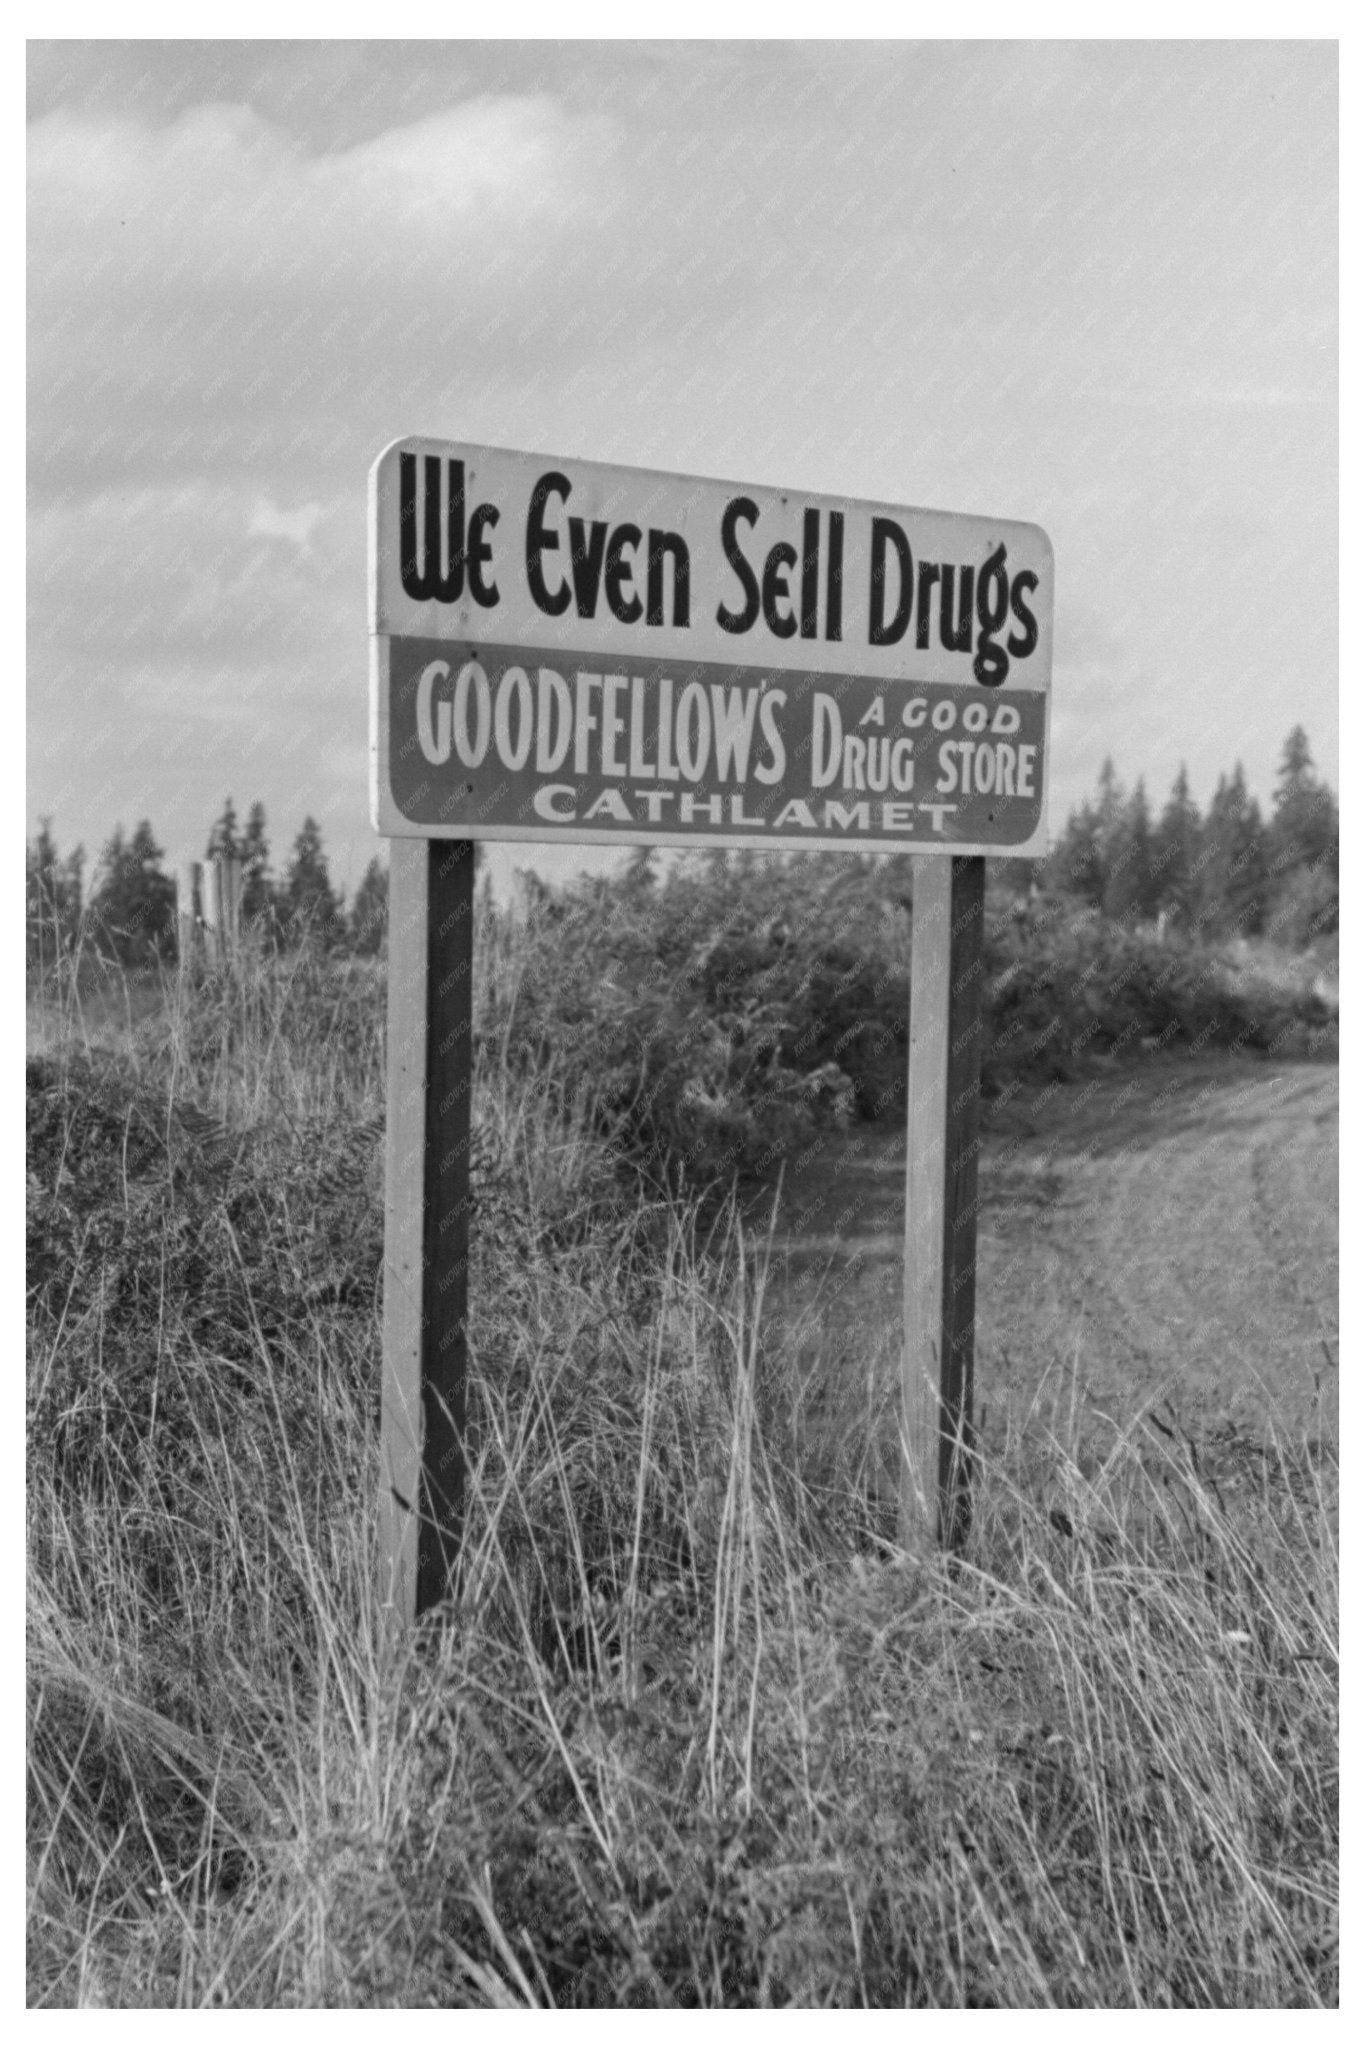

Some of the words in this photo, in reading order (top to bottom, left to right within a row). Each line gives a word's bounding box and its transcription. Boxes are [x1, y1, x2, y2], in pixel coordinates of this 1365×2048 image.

[400, 451, 501, 608] We
[526, 471, 690, 628] Even
[716, 497, 845, 641] Sell
[869, 515, 1039, 687] Drugs
[417, 660, 788, 785] GOODFELLOW'S
[811, 692, 915, 792] DRUG
[936, 740, 1037, 798] STORE
[859, 696, 886, 726] A
[902, 698, 1021, 734] GOOD
[533, 783, 958, 832] CATHLAMET
